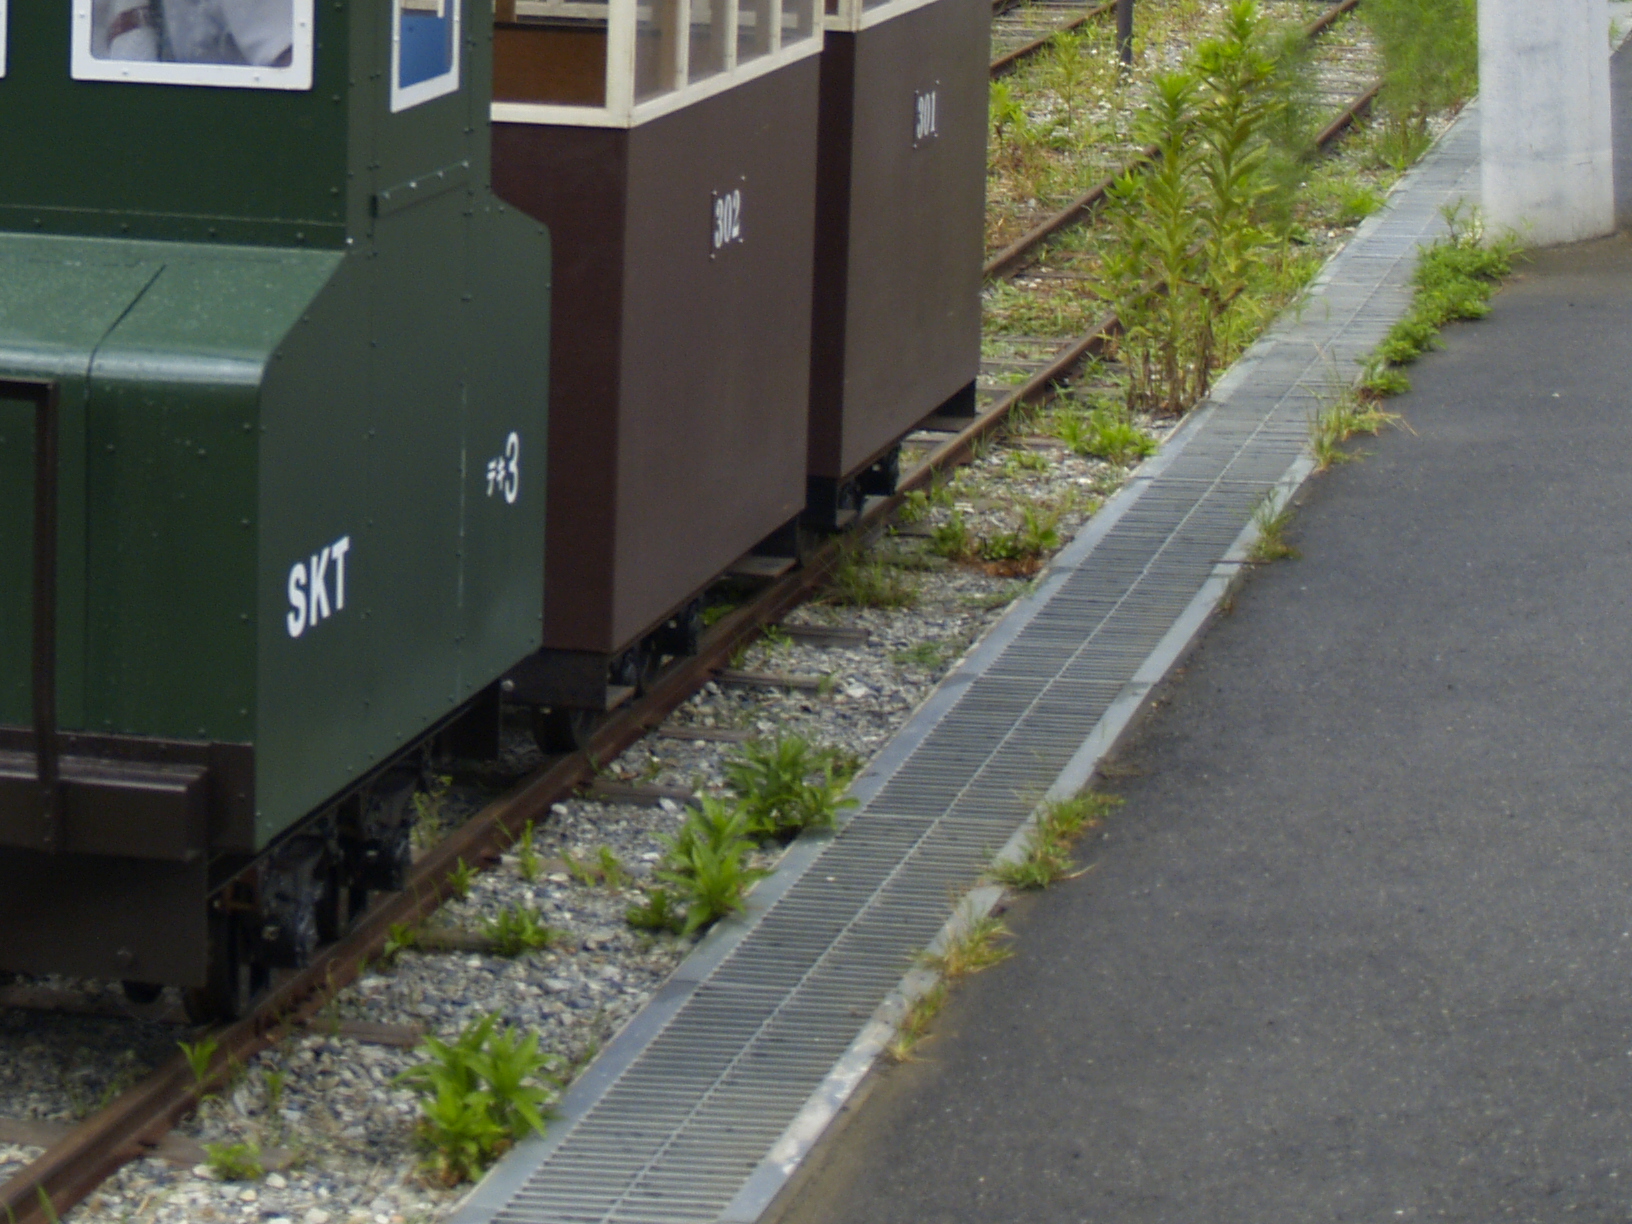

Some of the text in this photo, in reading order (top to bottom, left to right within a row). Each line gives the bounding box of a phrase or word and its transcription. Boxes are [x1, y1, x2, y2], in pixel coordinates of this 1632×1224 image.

[916, 90, 936, 139] 301
[714, 189, 741, 248] 302
[287, 536, 350, 638] SKT
